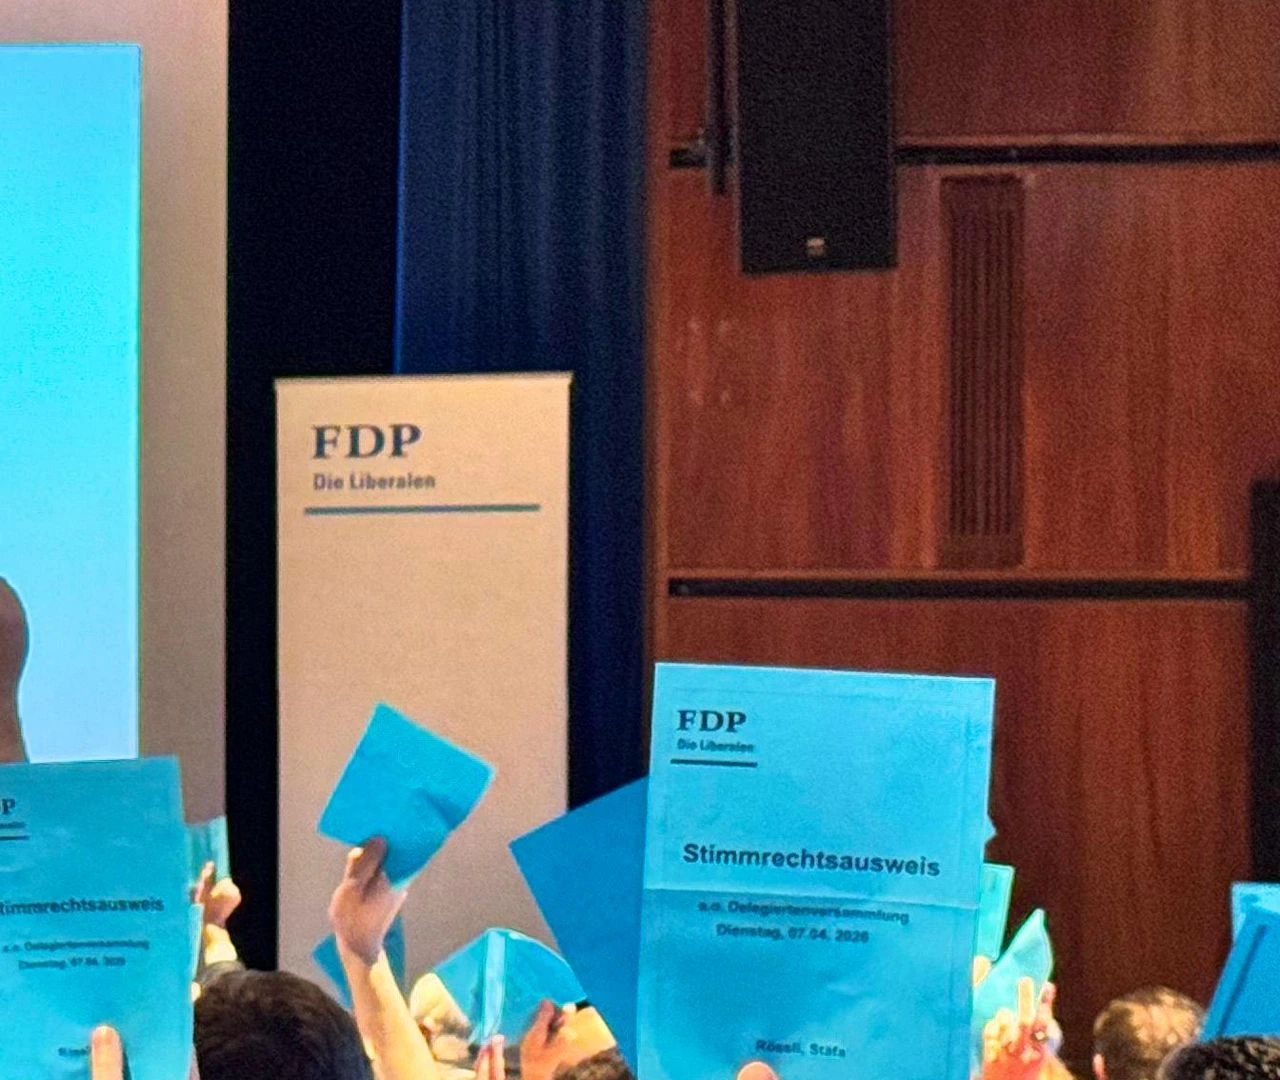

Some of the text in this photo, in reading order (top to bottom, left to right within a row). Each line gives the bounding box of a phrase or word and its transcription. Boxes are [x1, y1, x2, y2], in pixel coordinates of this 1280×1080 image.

[312, 424, 422, 460] FDP
[313, 472, 436, 491] Die Liberalen
[676, 709, 747, 733] FDP
[682, 843, 941, 877] Stimmrechtsausweis
[727, 900, 910, 926] Delegiertenversammlung
